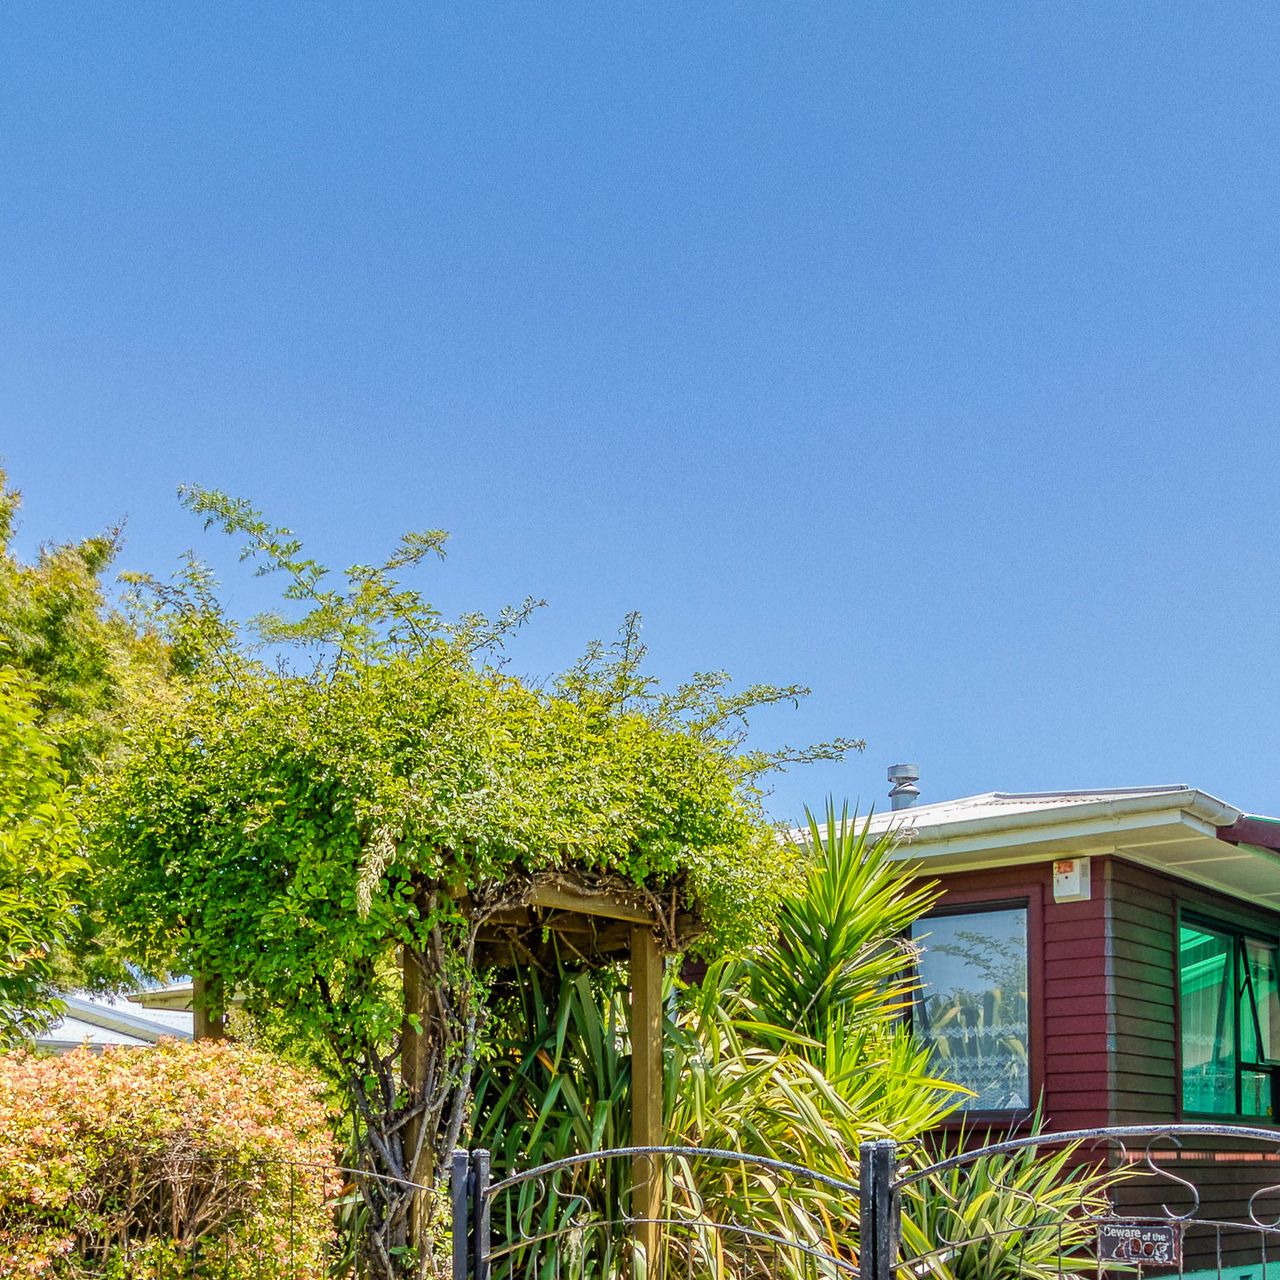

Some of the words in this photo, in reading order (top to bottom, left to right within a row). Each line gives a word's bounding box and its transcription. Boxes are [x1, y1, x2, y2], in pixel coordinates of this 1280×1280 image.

[1103, 1226, 1141, 1238] Beware
[1142, 1232, 1151, 1241] of
[1152, 1232, 1166, 1242] the
